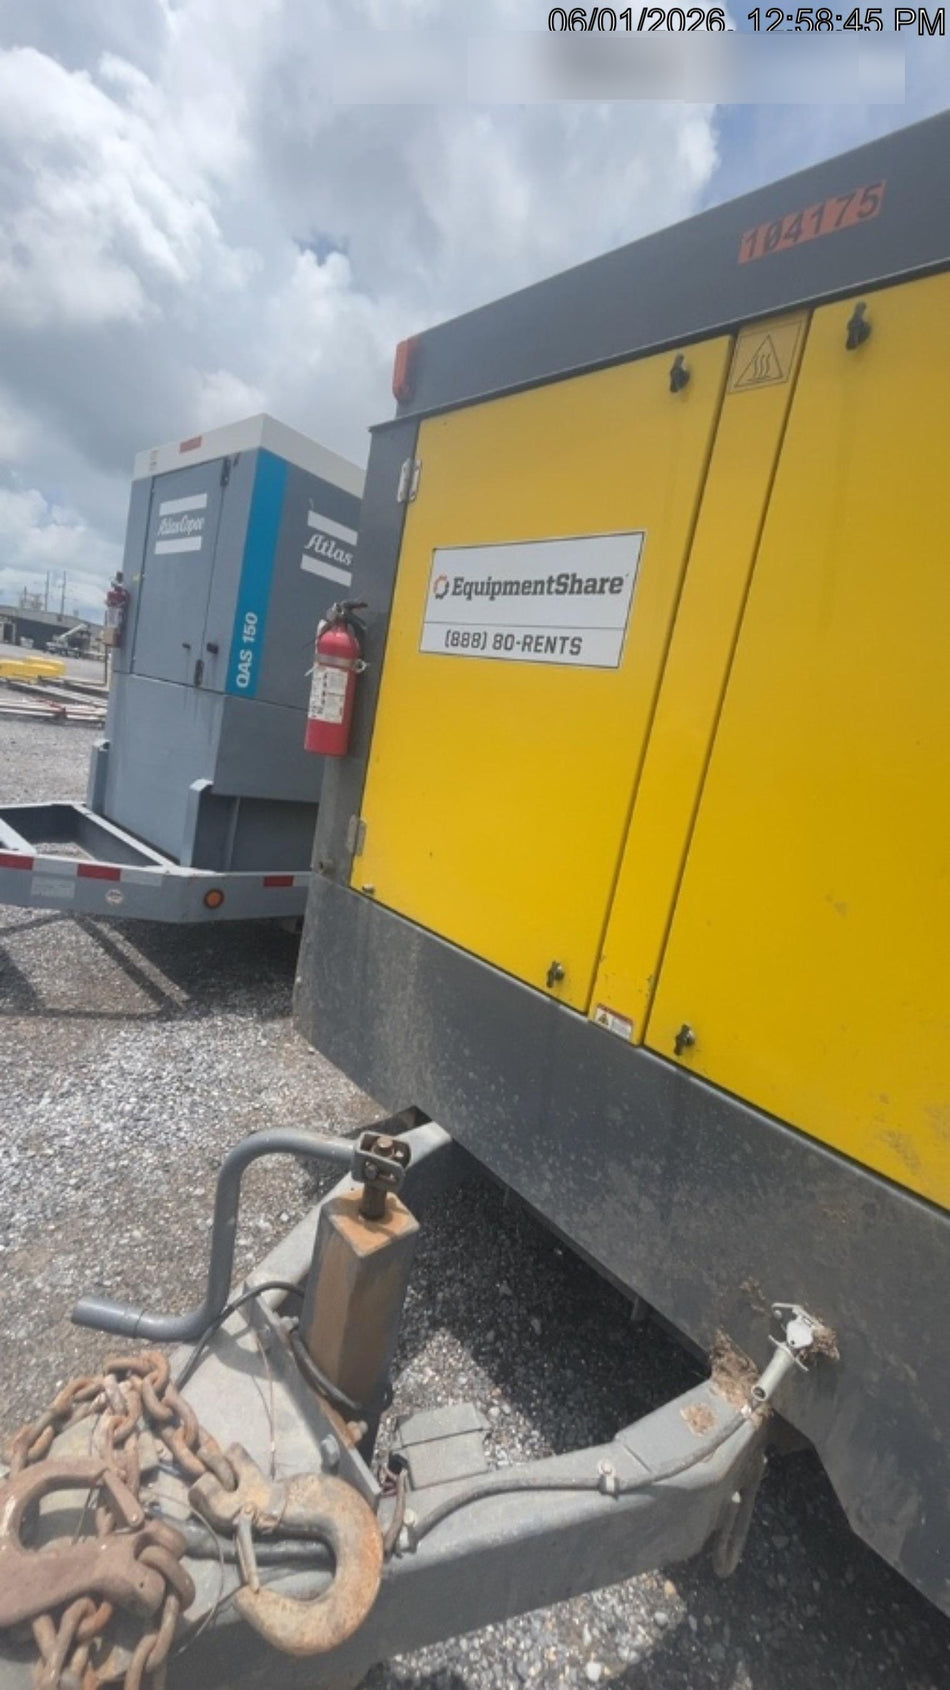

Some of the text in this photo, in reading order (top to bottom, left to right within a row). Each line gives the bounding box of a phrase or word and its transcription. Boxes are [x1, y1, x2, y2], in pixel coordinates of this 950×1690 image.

[743, 181, 882, 259] 104175
[304, 534, 353, 566] Atlas
[451, 572, 624, 600] EquipmentShare
[236, 612, 258, 688] QAS 150
[444, 629, 583, 656] (888) 80-RENTS
